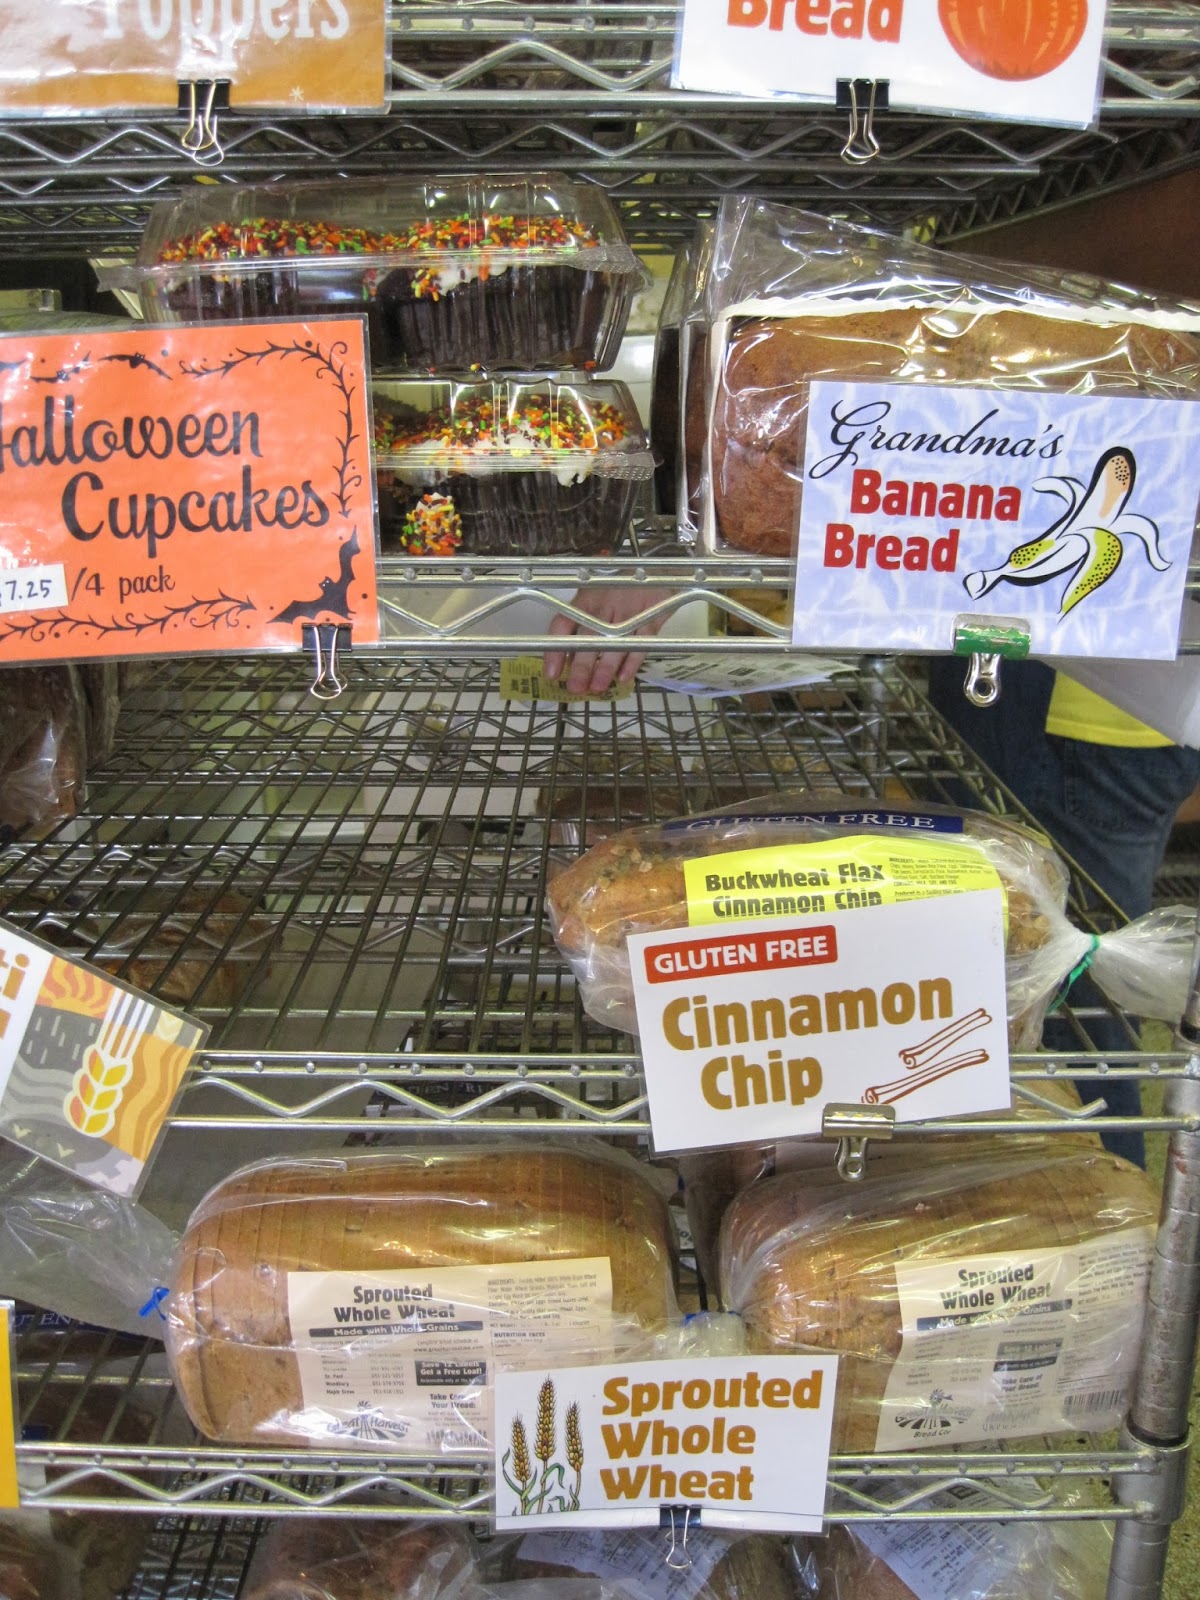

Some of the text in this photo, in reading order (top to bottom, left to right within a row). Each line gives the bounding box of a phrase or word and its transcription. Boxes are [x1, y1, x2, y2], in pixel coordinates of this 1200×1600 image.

[0, 395, 263, 473] alloween
[809, 400, 1064, 479] Grandma's
[61, 465, 330, 559] Cupcakes
[850, 469, 1022, 521] Banana
[823, 523, 960, 573] Bread
[0, 578, 52, 606] 7.25
[119, 565, 175, 604] pack
[838, 813, 935, 829] FREE
[705, 862, 884, 892] Buckwheat Flax
[713, 888, 883, 918] Cinnamon Chip
[654, 935, 829, 974] GLUTEN FREE
[662, 975, 953, 1051] Cinnamon
[701, 1049, 823, 1110] Chip
[353, 1284, 432, 1304] Sprouted
[958, 1264, 1034, 1287] Sprouted
[334, 1304, 455, 1322] Whole Wheat
[940, 1282, 1051, 1309] Whole Wheat
[334, 1328, 363, 1336] Made
[366, 1326, 387, 1335] with
[426, 1323, 459, 1332] Grains
[940, 1315, 967, 1326] Made
[1022, 1305, 1051, 1315] Grains
[602, 1370, 823, 1417] Sprouted
[601, 1417, 756, 1460] Whole
[600, 1464, 754, 1501] Wheat
